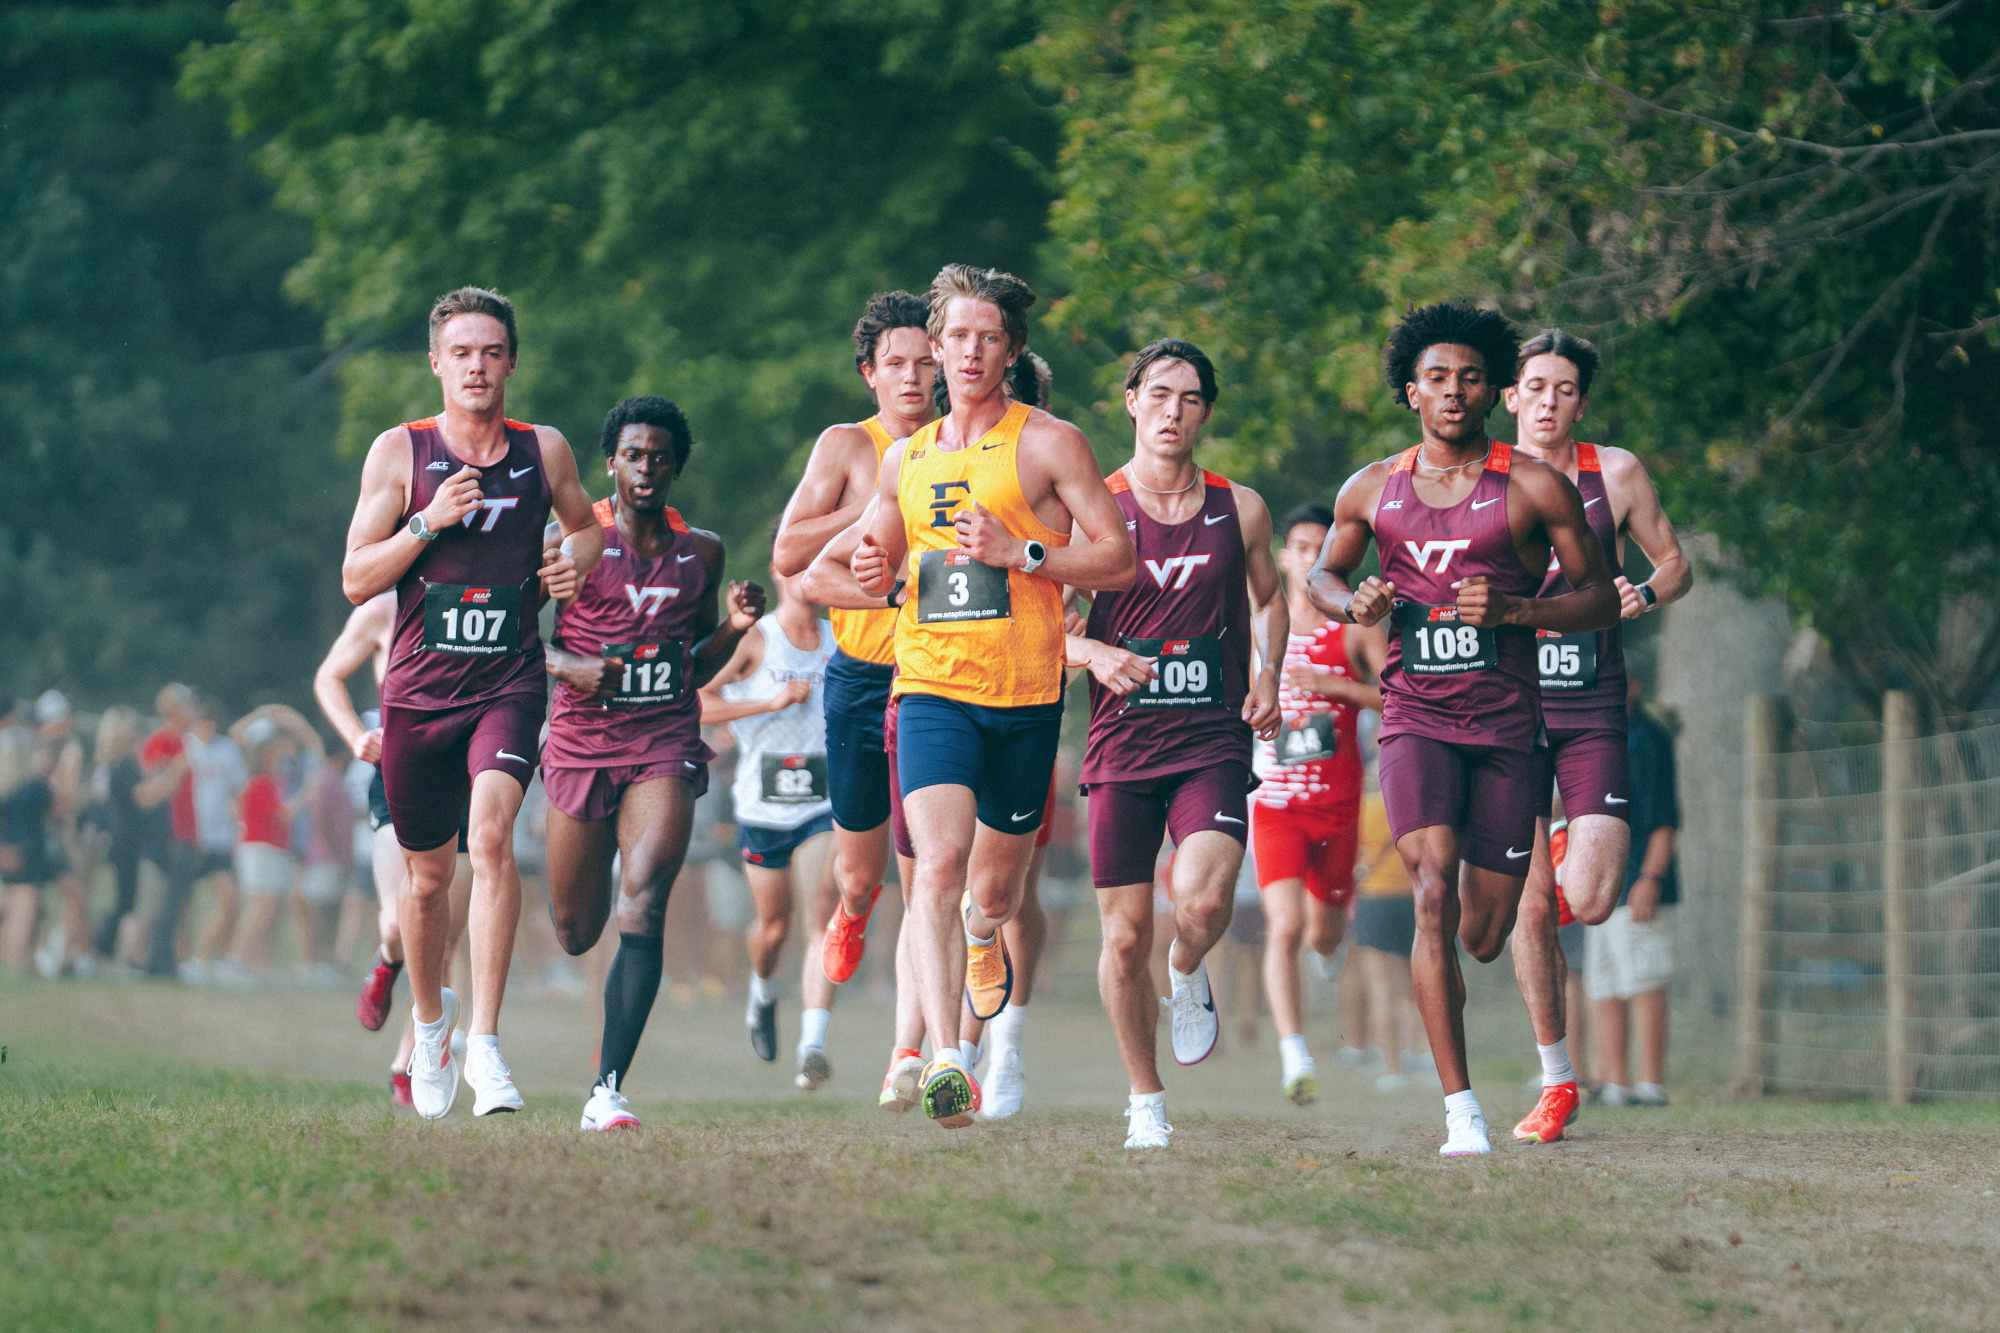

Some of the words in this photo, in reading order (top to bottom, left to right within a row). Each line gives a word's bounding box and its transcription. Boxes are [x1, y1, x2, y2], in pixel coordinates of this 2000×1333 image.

[425, 460, 449, 472] ACC
[1382, 499, 1404, 510] ACC
[1402, 537, 1473, 574] VT
[1143, 553, 1212, 590] VT
[624, 583, 680, 615] VT
[948, 571, 970, 606] 3
[441, 607, 506, 643] 107
[927, 608, 998, 620] www.snaptiming.com
[436, 642, 508, 654] www.snaptiming.com
[1415, 625, 1480, 661] 108
[1413, 659, 1485, 673] www.snaptiming.com
[1538, 643, 1580, 676] 05
[622, 661, 672, 692] 112
[1149, 660, 1208, 693] 109
[1139, 696, 1212, 705] www.snaptiming.com
[775, 768, 813, 797] 82
